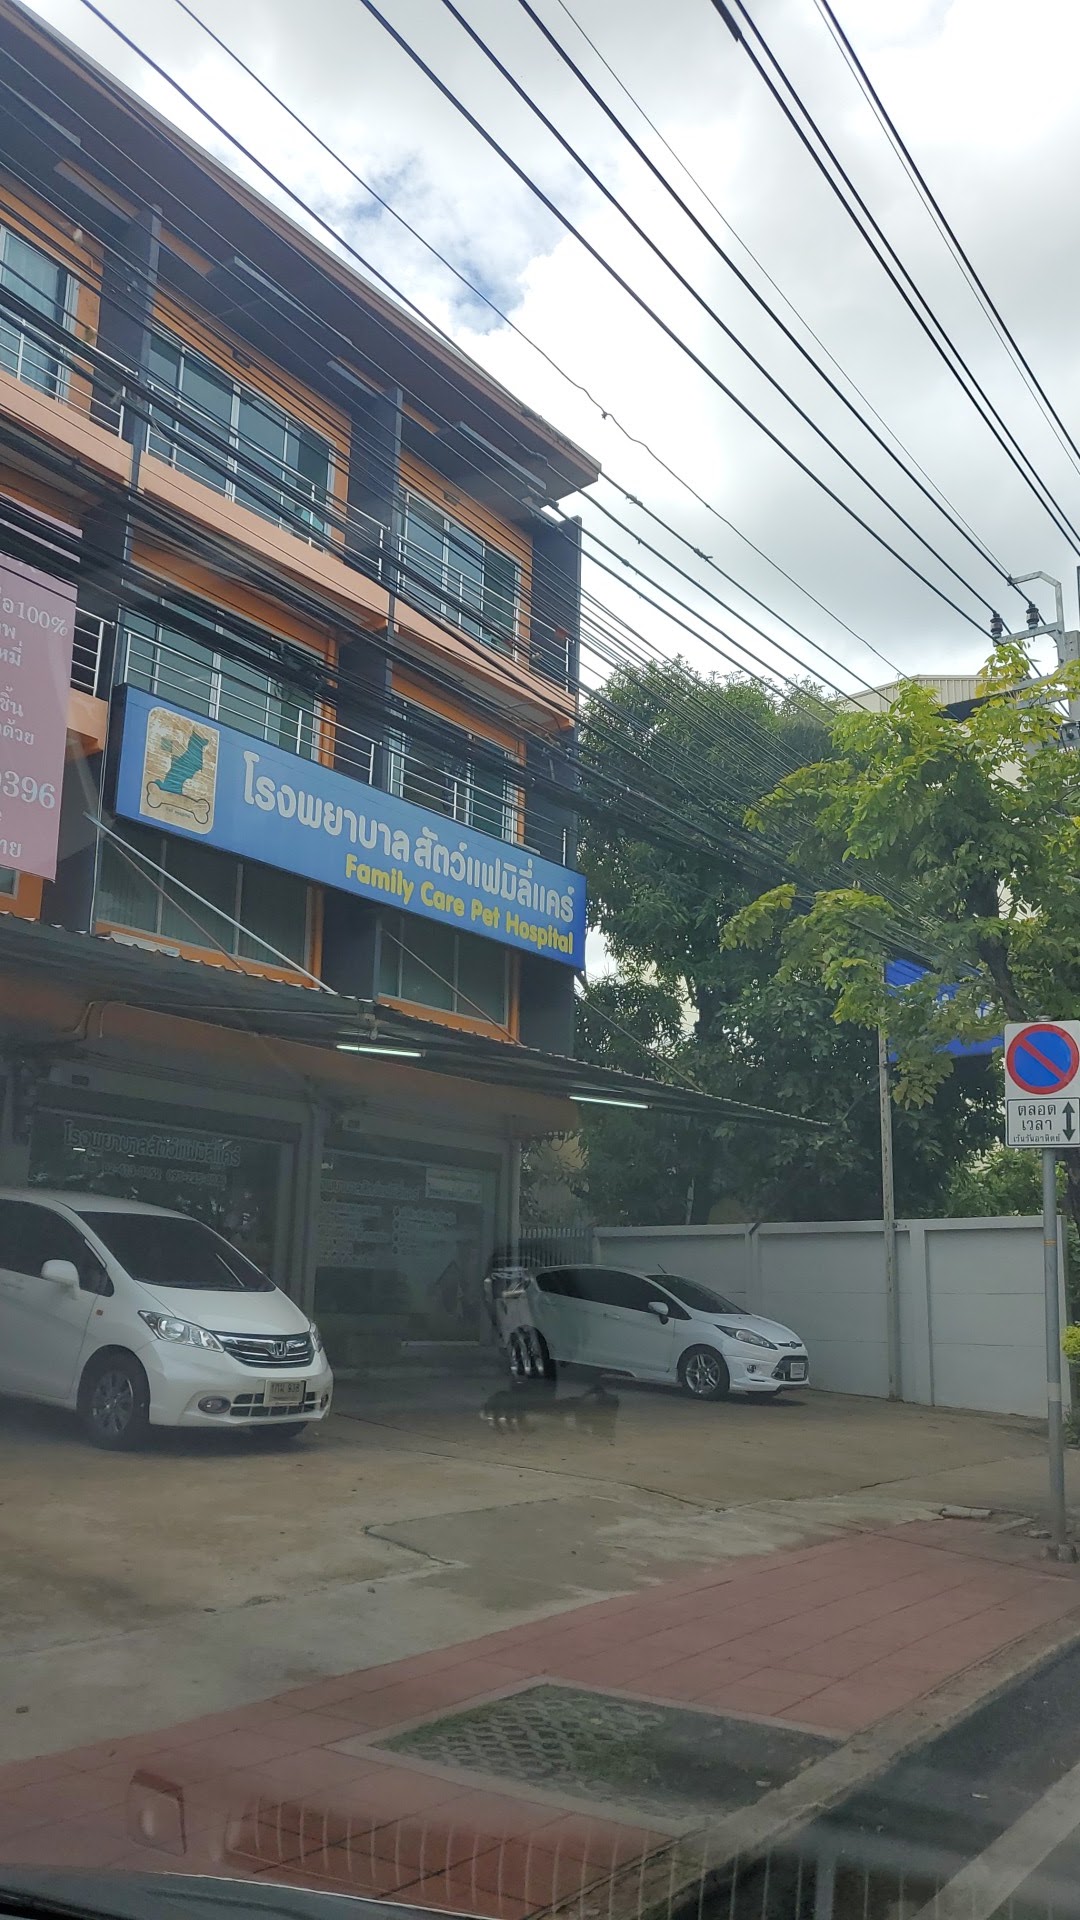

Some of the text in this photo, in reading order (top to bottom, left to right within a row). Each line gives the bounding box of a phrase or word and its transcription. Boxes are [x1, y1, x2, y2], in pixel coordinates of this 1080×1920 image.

[0, 717, 34, 746] ด้วย
[0, 770, 56, 810] 396
[243, 750, 575, 923] โรงพยาบาล สัตว์แฟมิลี่แคร์
[345, 853, 574, 955] Family Care Pet Hospital
[1018, 1104, 1056, 1116] ตลอด
[1022, 1119, 1053, 1131] เวลา
